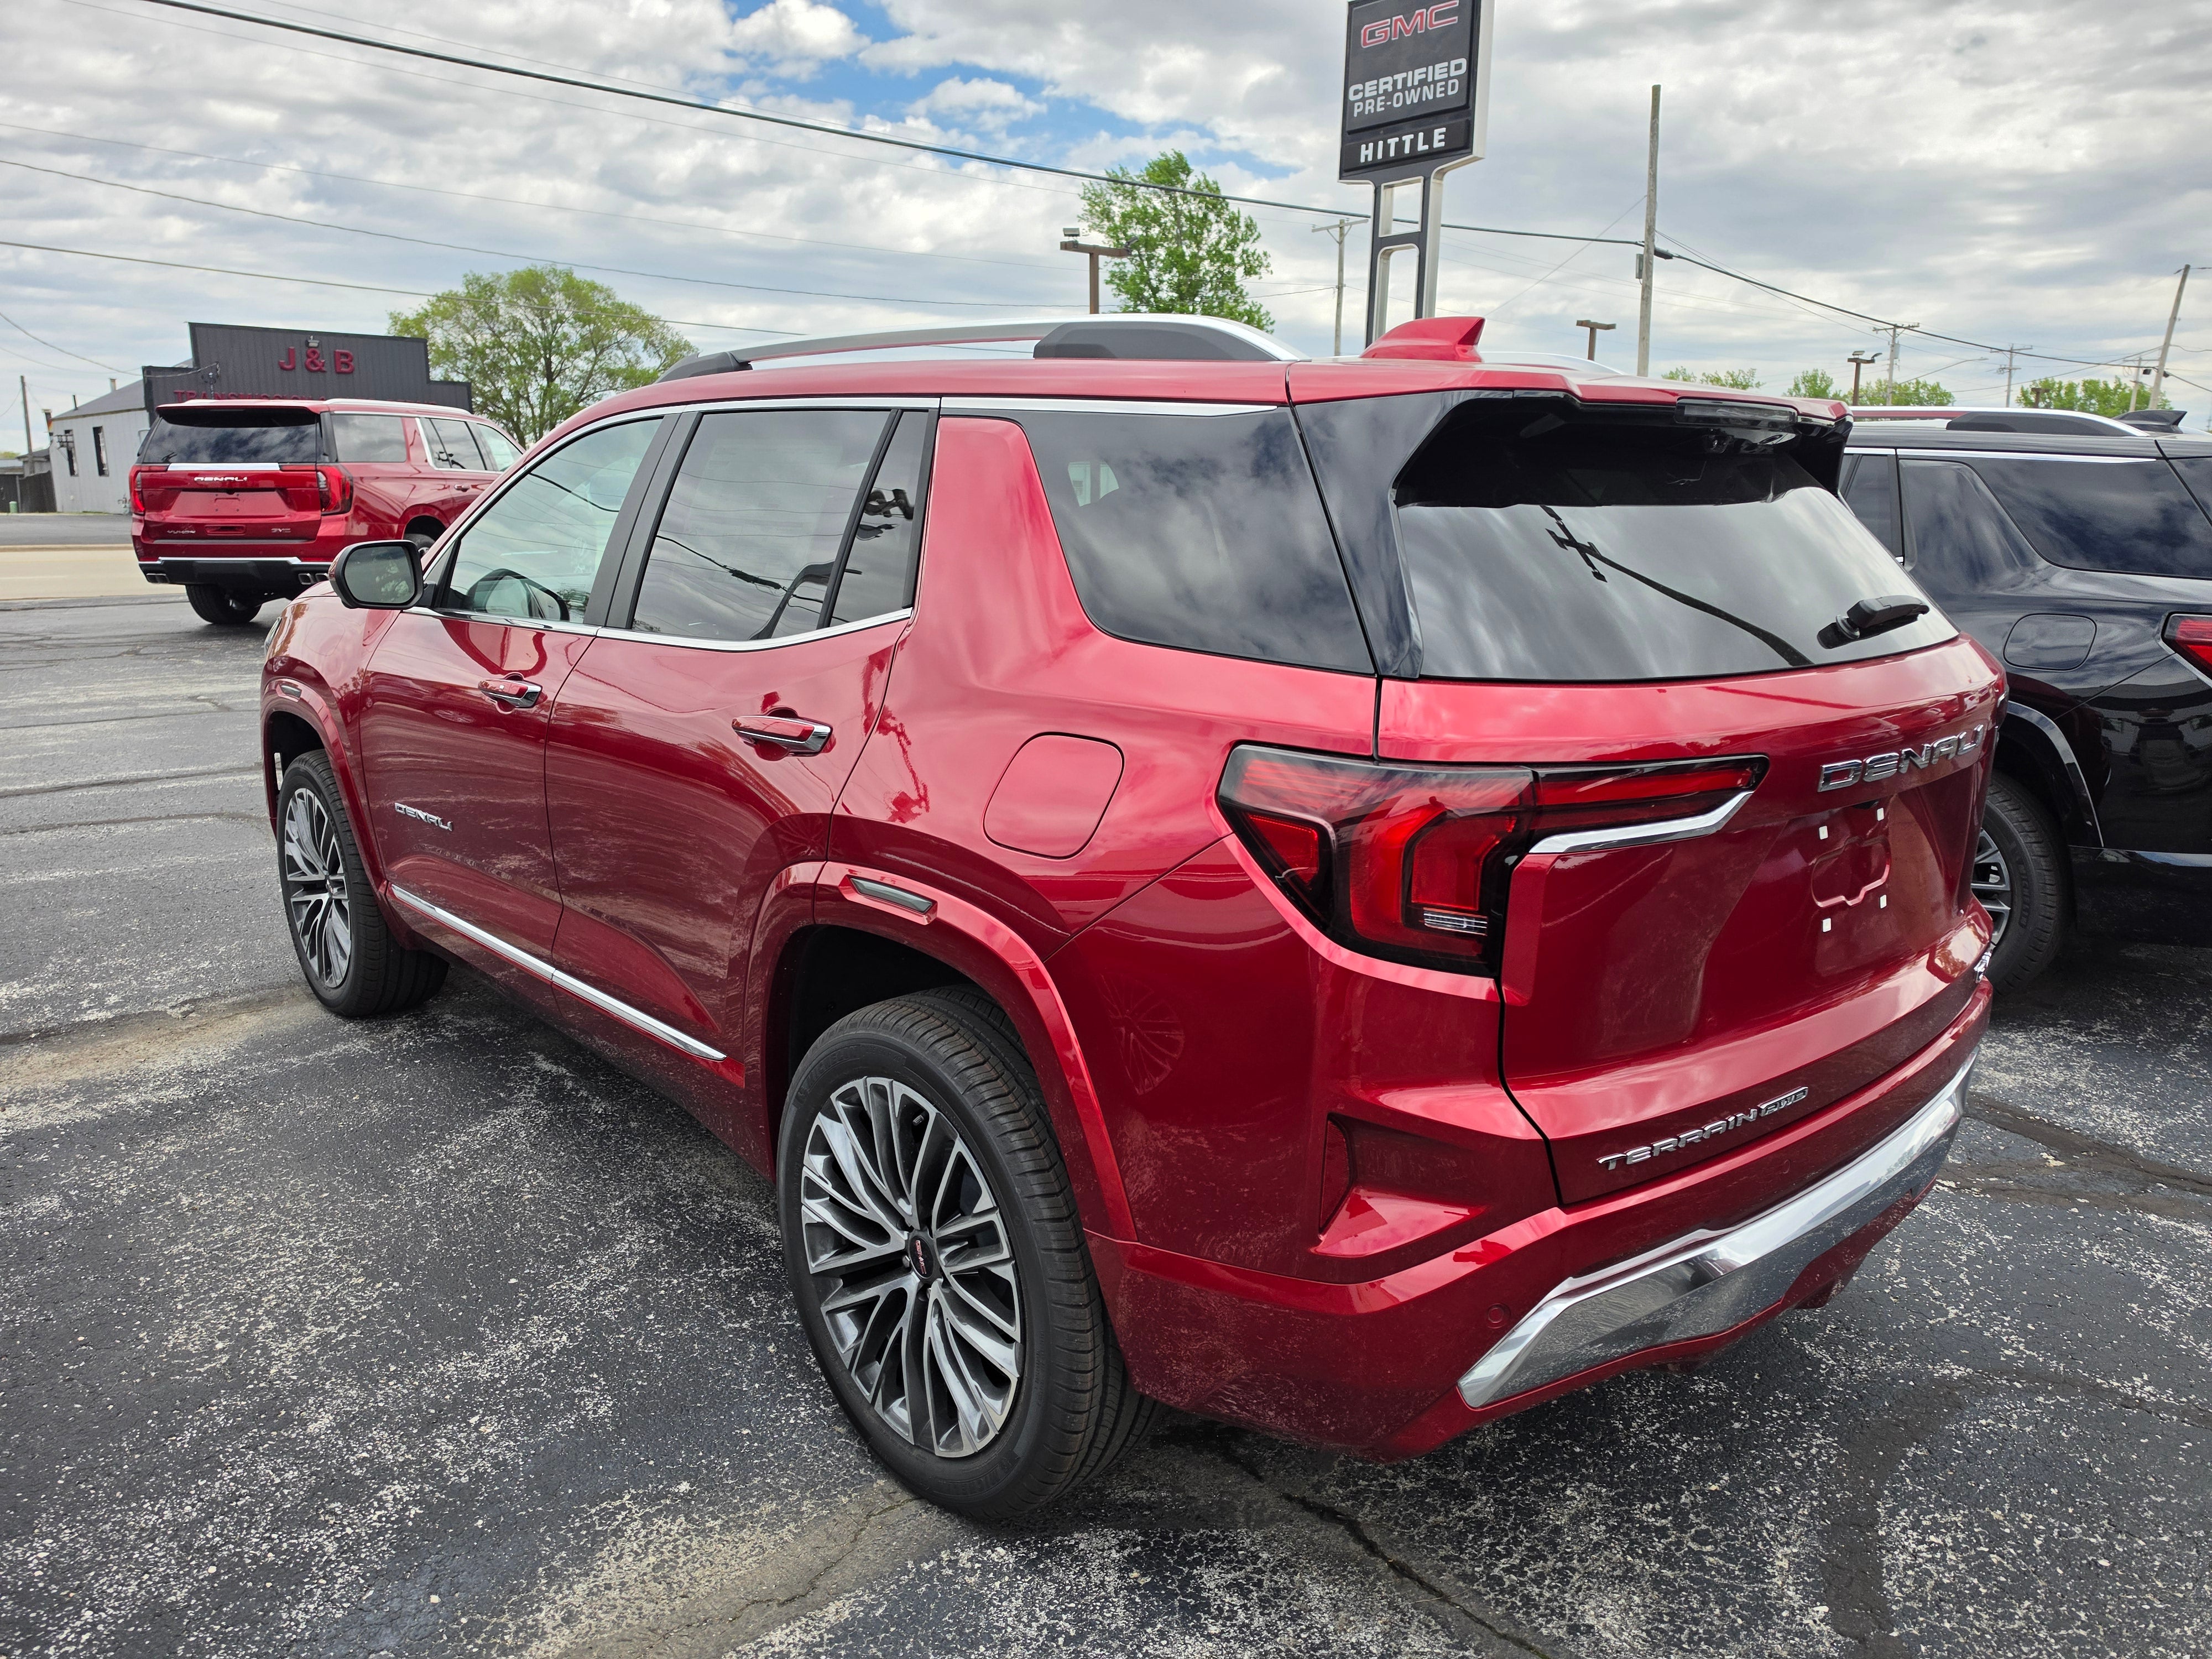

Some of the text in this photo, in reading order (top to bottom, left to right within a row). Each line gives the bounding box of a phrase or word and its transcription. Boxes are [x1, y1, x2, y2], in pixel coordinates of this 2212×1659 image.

[1361, 0, 1459, 48] GMC
[1349, 58, 1467, 101] CERTIFIED
[1354, 79, 1459, 117] PRE-OWNED
[1360, 127, 1446, 163] HITTLE
[278, 346, 355, 374] J & B
[1817, 724, 1984, 792] DENALI
[394, 802, 453, 832] DENALI
[1597, 1108, 1757, 1171] TERRAIN
